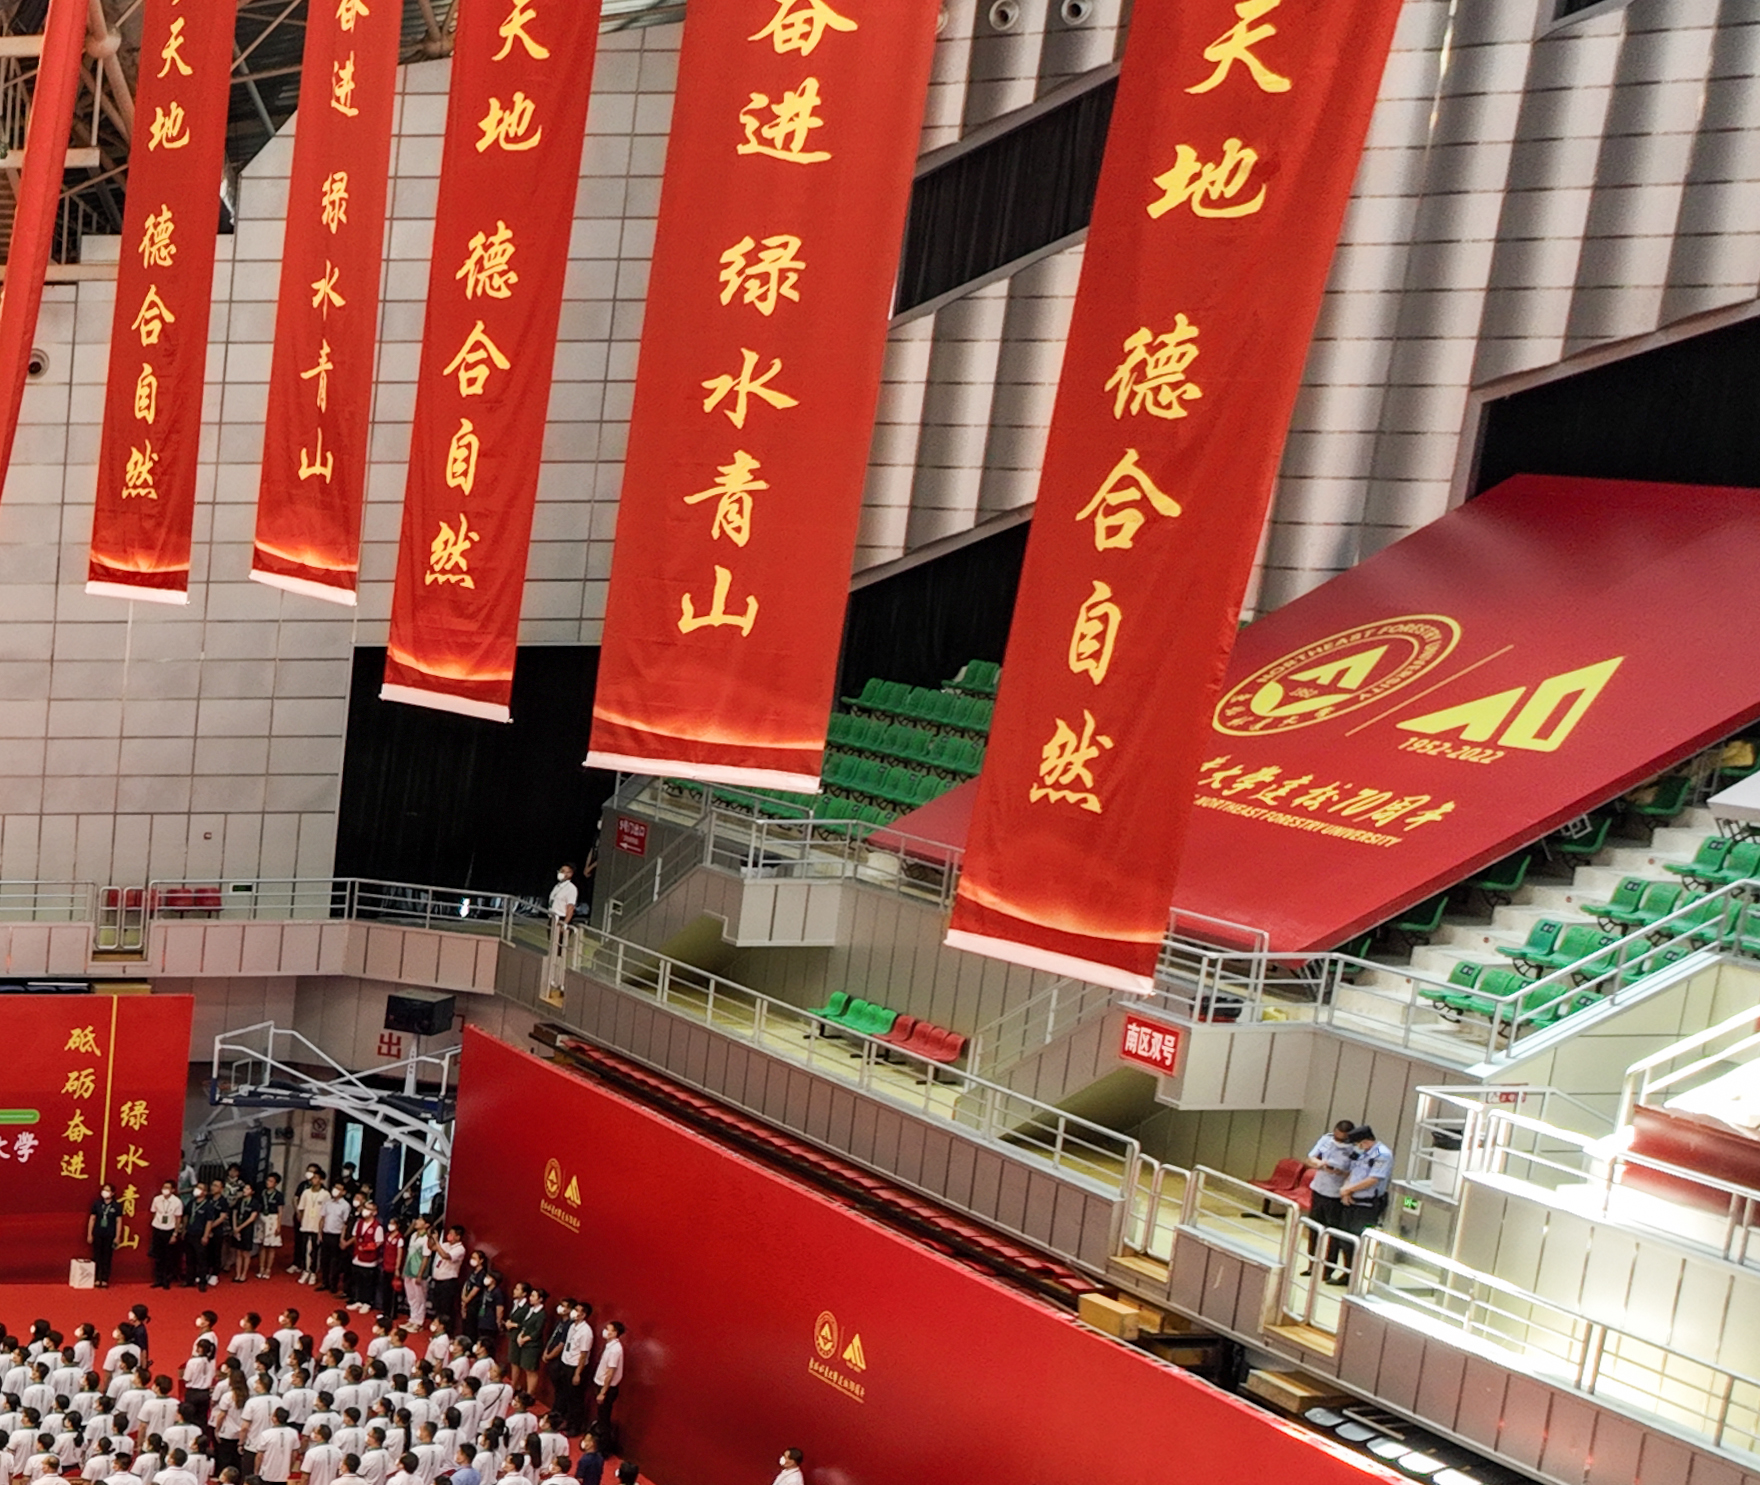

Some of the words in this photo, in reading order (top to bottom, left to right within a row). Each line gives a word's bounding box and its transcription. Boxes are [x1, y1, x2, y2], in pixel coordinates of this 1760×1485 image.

[148, 0, 193, 151] 天地
[476, 0, 549, 152] 天地
[1147, 0, 1291, 219] 天地
[122, 204, 177, 499] 德合自然
[298, 172, 348, 483] 绿水青山
[424, 221, 518, 589] 德合自然
[678, 235, 806, 636] 绿水青山
[1029, 313, 1202, 813] 德合自然
[1257, 628, 1377, 684] NORTHEAST
[1398, 736, 1505, 764] 1952-2022
[60, 1026, 102, 1180] 砥砺奋进
[1123, 1021, 1176, 1067] 南区双号
[117, 1100, 150, 1250] 绿水青山
